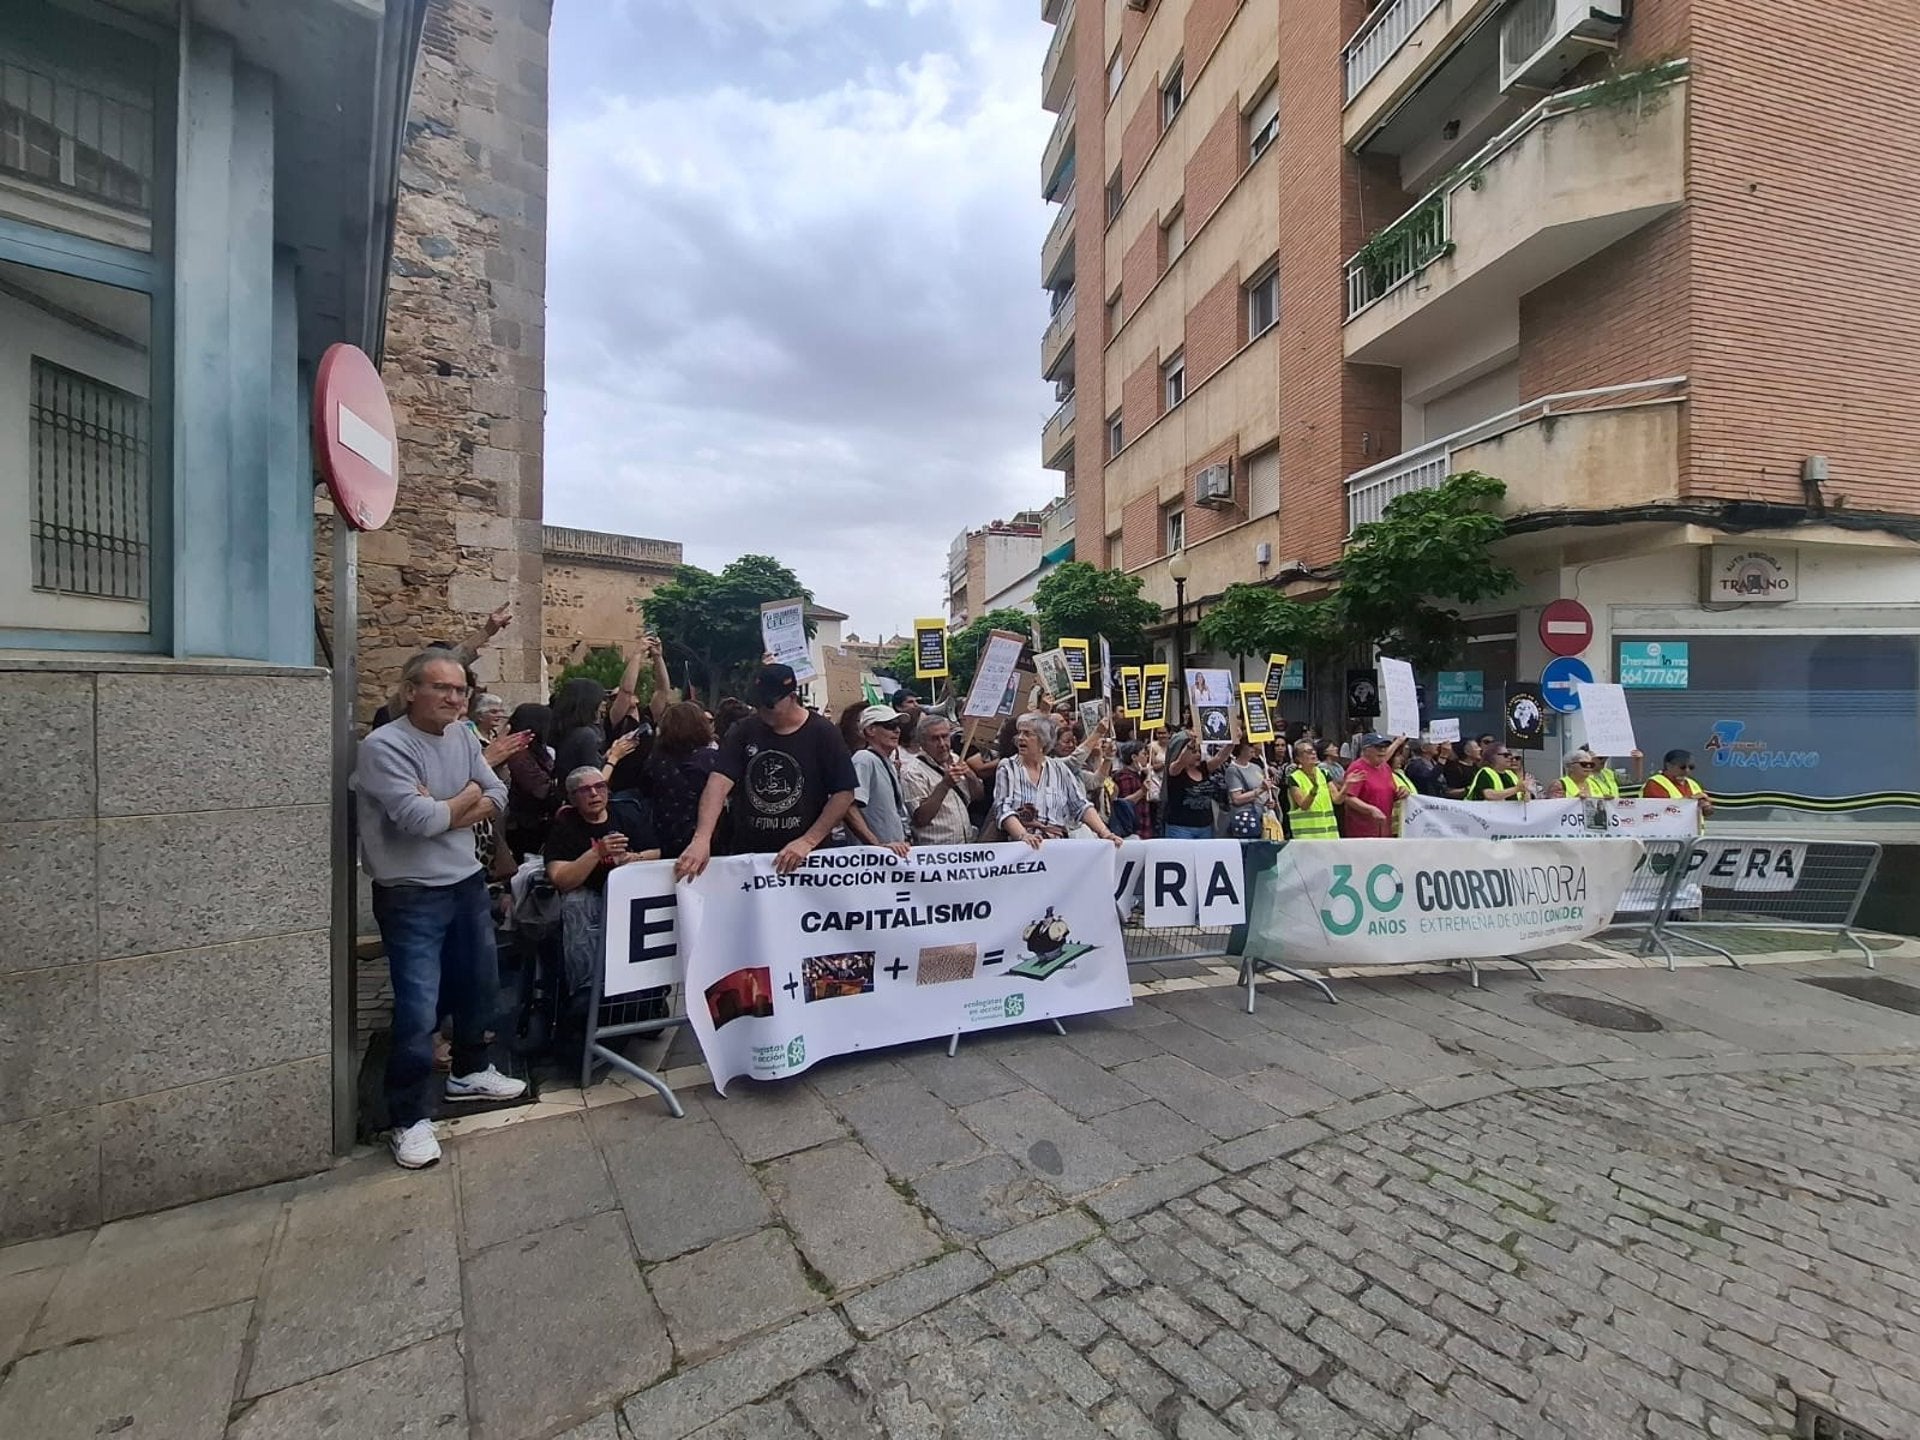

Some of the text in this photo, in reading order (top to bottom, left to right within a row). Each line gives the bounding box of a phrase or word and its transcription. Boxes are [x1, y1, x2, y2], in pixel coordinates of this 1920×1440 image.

[1621, 668, 1688, 685] 664777672
[916, 850, 996, 866] FASCISMO
[891, 871, 916, 884] DE
[920, 870, 943, 883] LA
[946, 860, 1048, 882] NATURALEZA
[1415, 865, 1587, 912] COORDINADORA
[1320, 863, 1404, 937] 30
[801, 900, 992, 933] CAPITALISMO
[1367, 917, 1407, 935] AÑOS
[1420, 912, 1496, 933] EXTREMEÑA
[1497, 913, 1511, 929] DE
